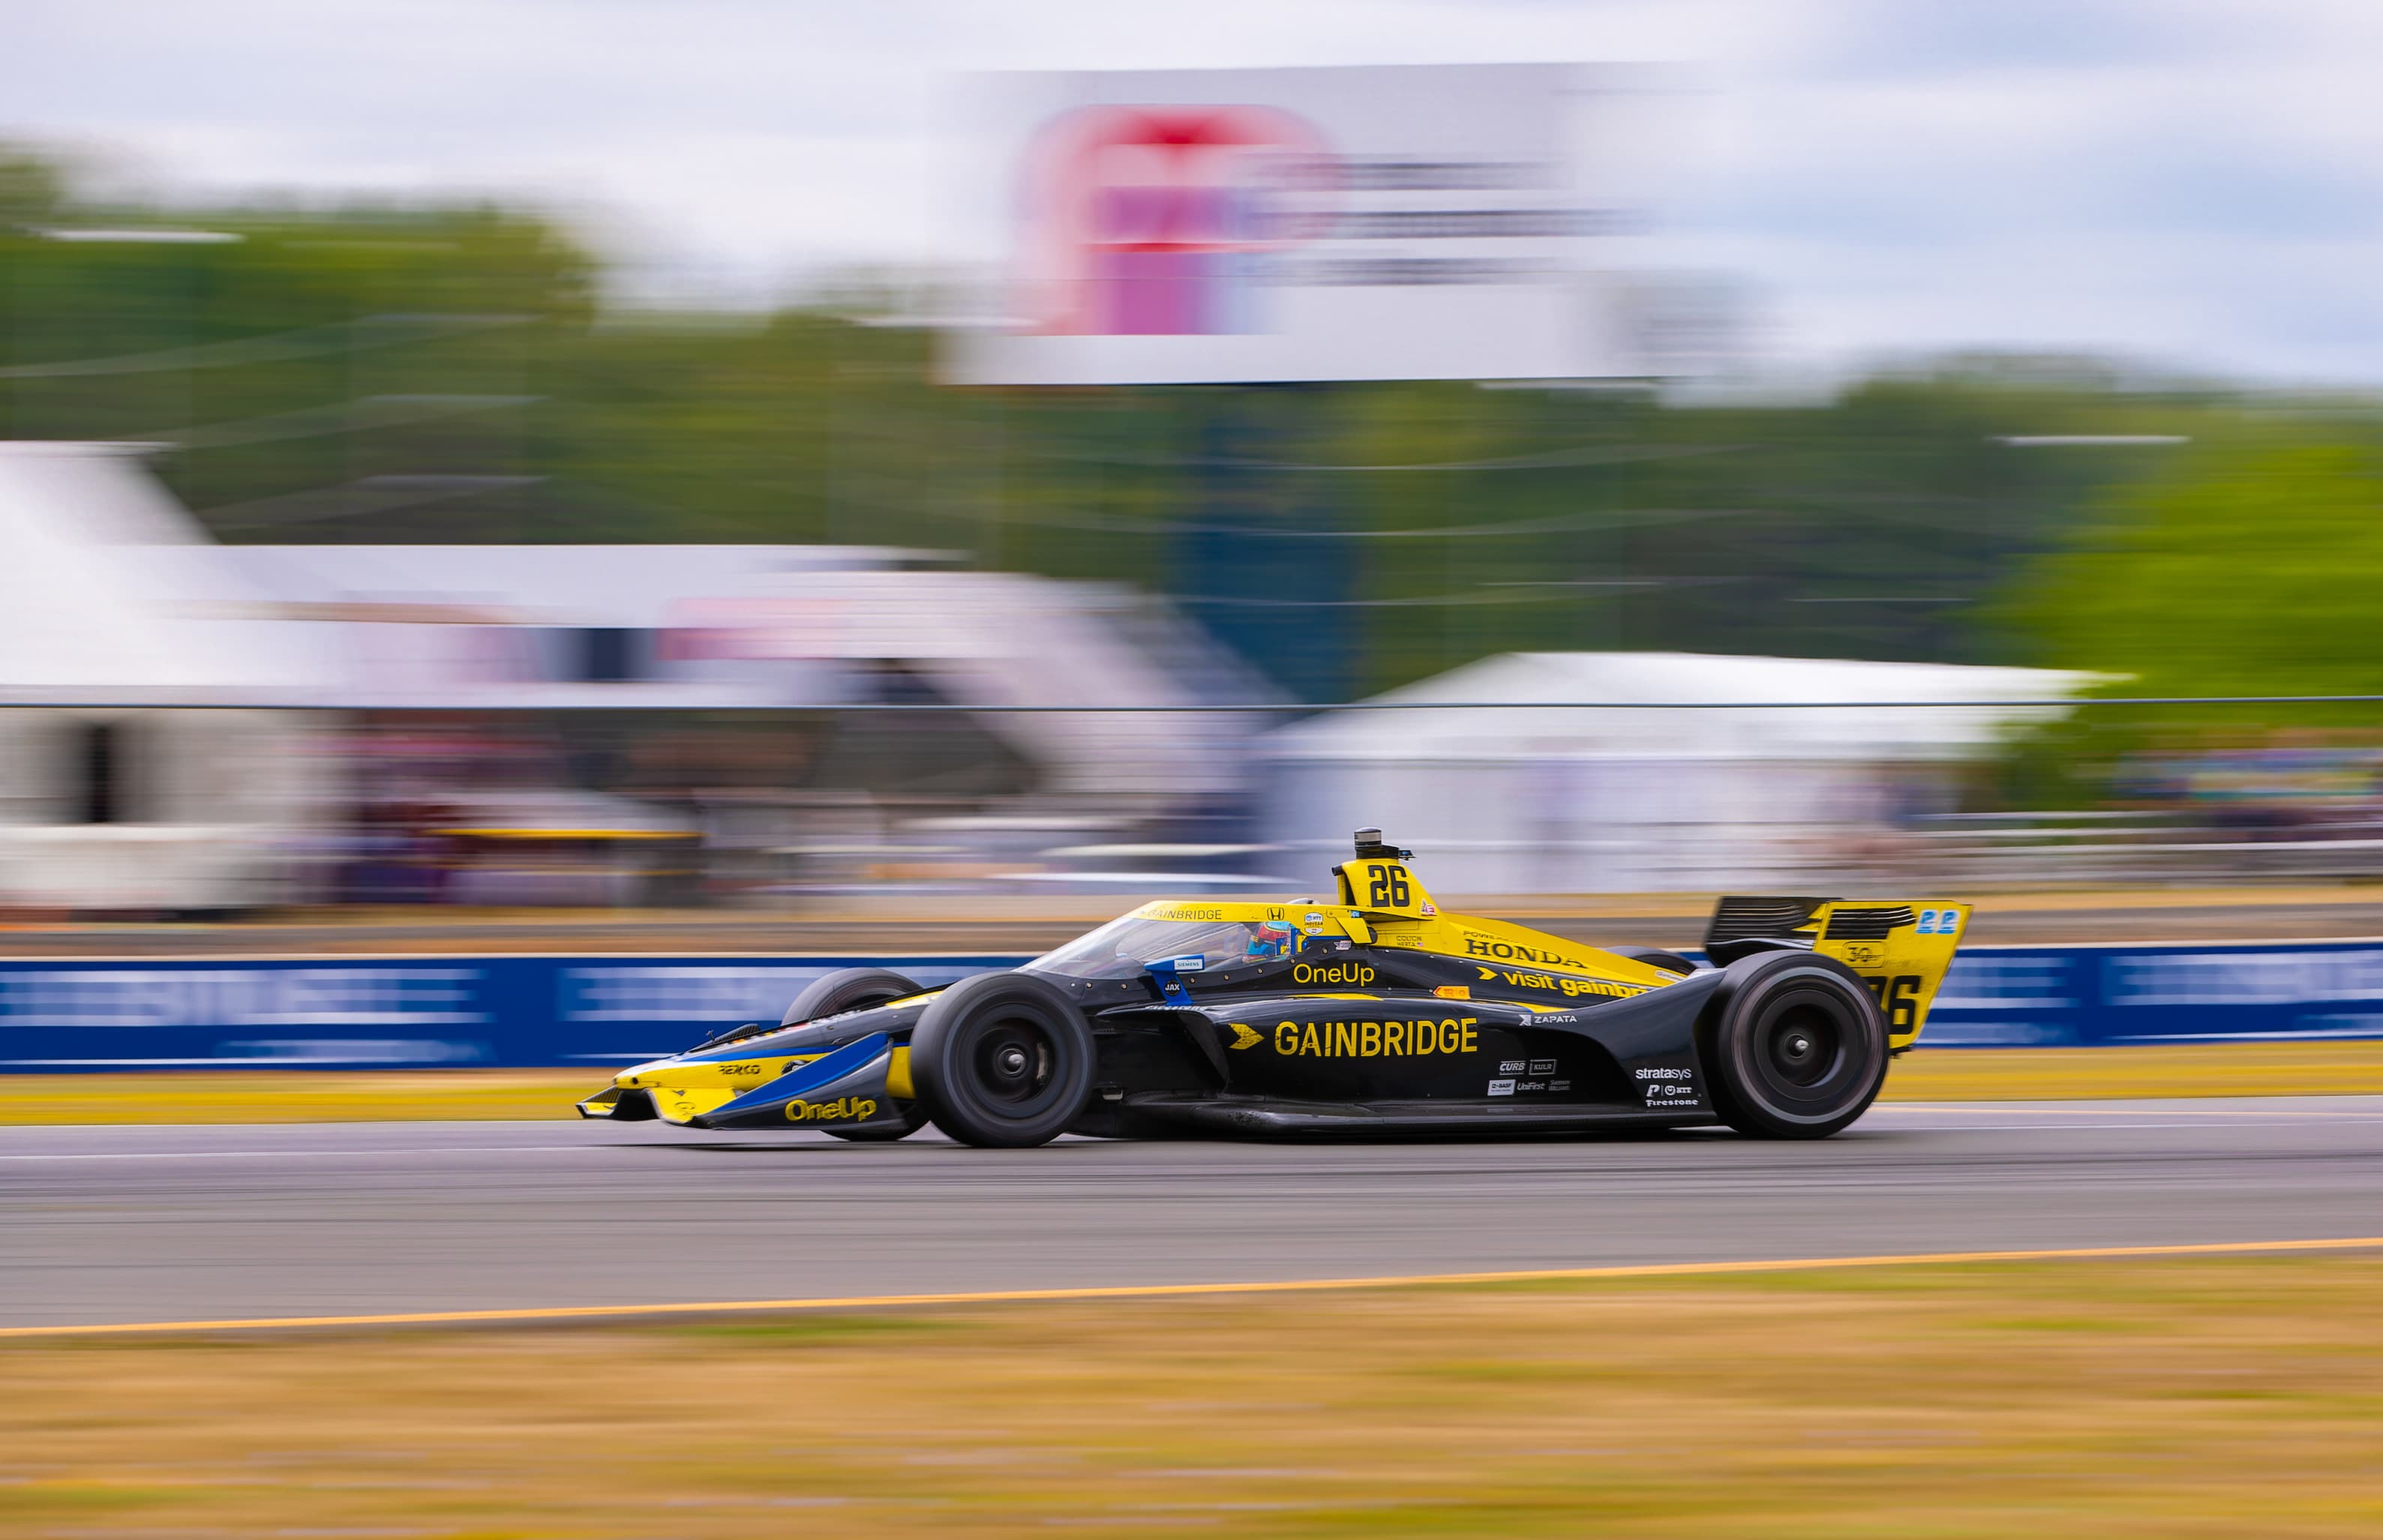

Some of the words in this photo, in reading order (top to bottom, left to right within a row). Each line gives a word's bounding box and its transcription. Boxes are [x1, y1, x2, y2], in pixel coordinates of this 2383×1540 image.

[1367, 865, 1410, 908] 26
[1464, 938, 1588, 968] HONDA
[1293, 963, 1375, 987] OneUp
[1502, 971, 1558, 990] visit
[1534, 1015, 1577, 1023] ZAPATA
[1275, 1018, 1478, 1056] GAINBRIDGE
[1499, 1062, 1525, 1071] CURB
[1635, 1067, 1692, 1080] stratasys
[1517, 1082, 1545, 1091] UniFirst
[785, 1096, 877, 1122] OneUp
[1645, 1099, 1699, 1107] Firestone
